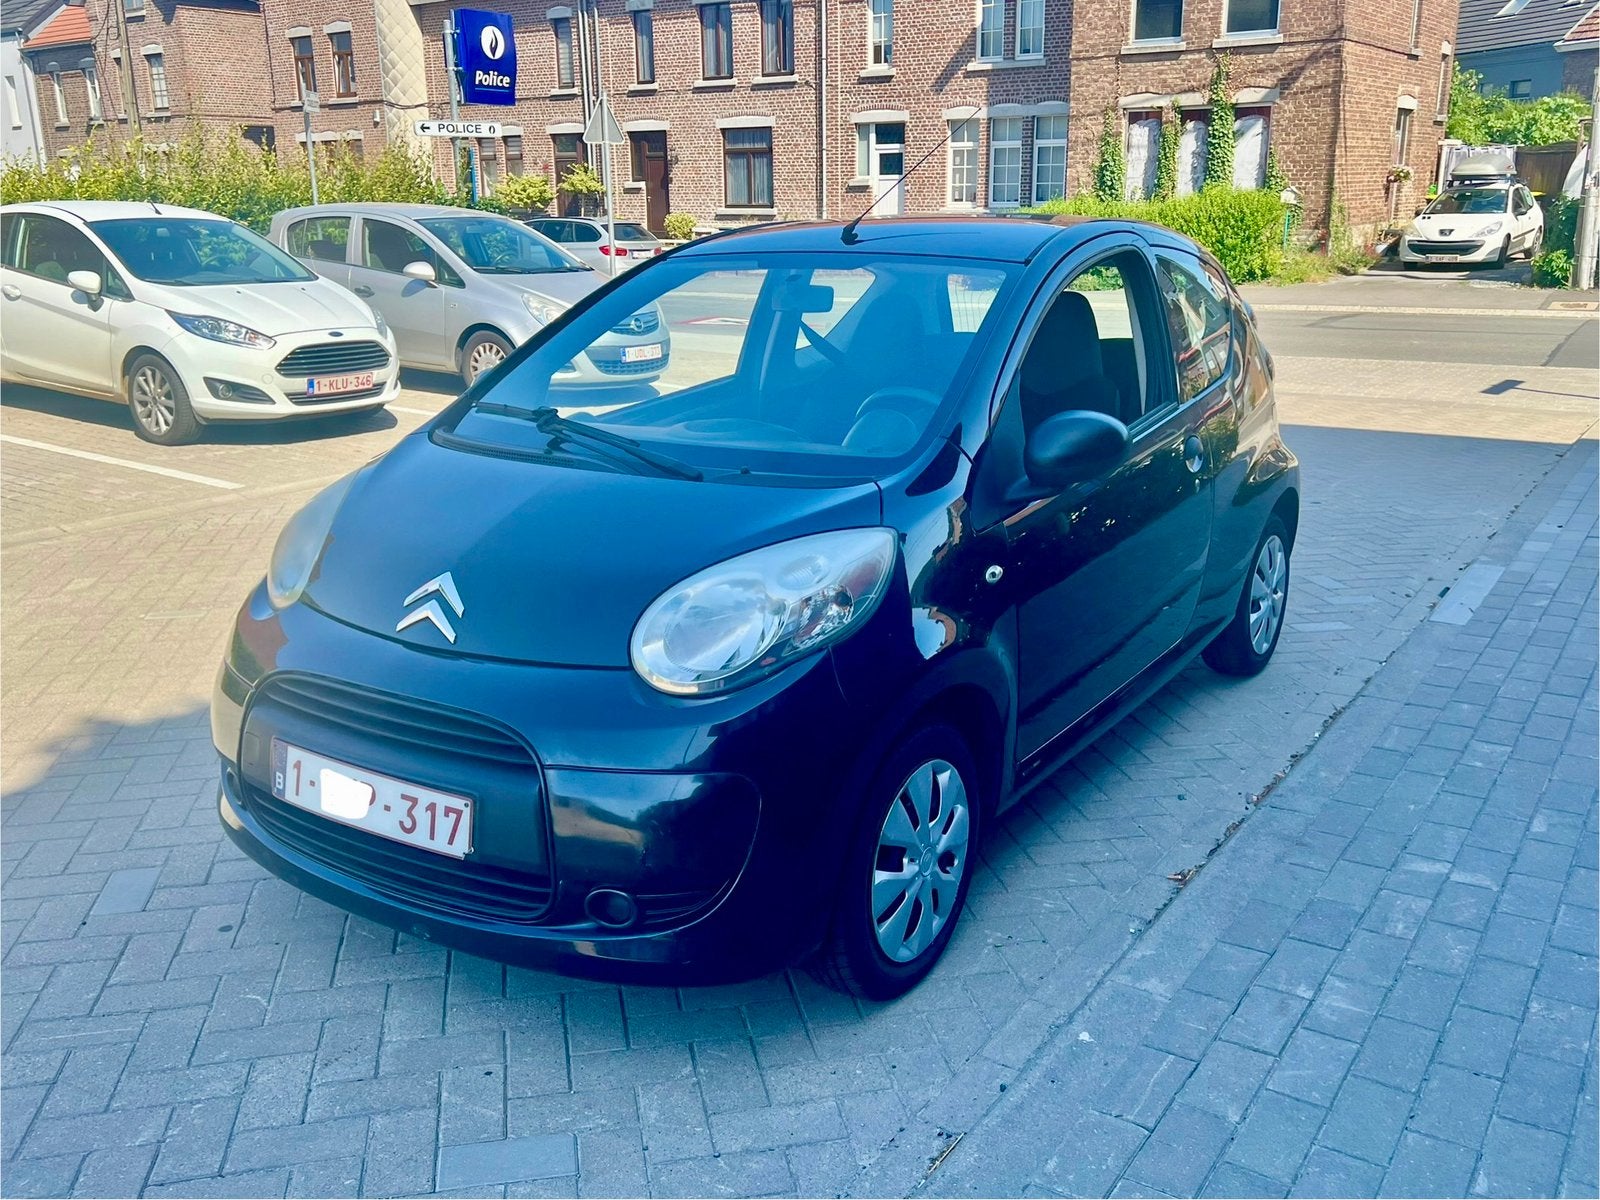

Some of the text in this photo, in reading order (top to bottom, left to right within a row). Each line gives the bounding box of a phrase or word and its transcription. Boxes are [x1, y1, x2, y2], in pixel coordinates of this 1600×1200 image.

[475, 70, 510, 87] Police
[437, 123, 483, 134] POLICE
[315, 375, 371, 391] 1-KLU-346
[275, 759, 464, 846] B 1--317
